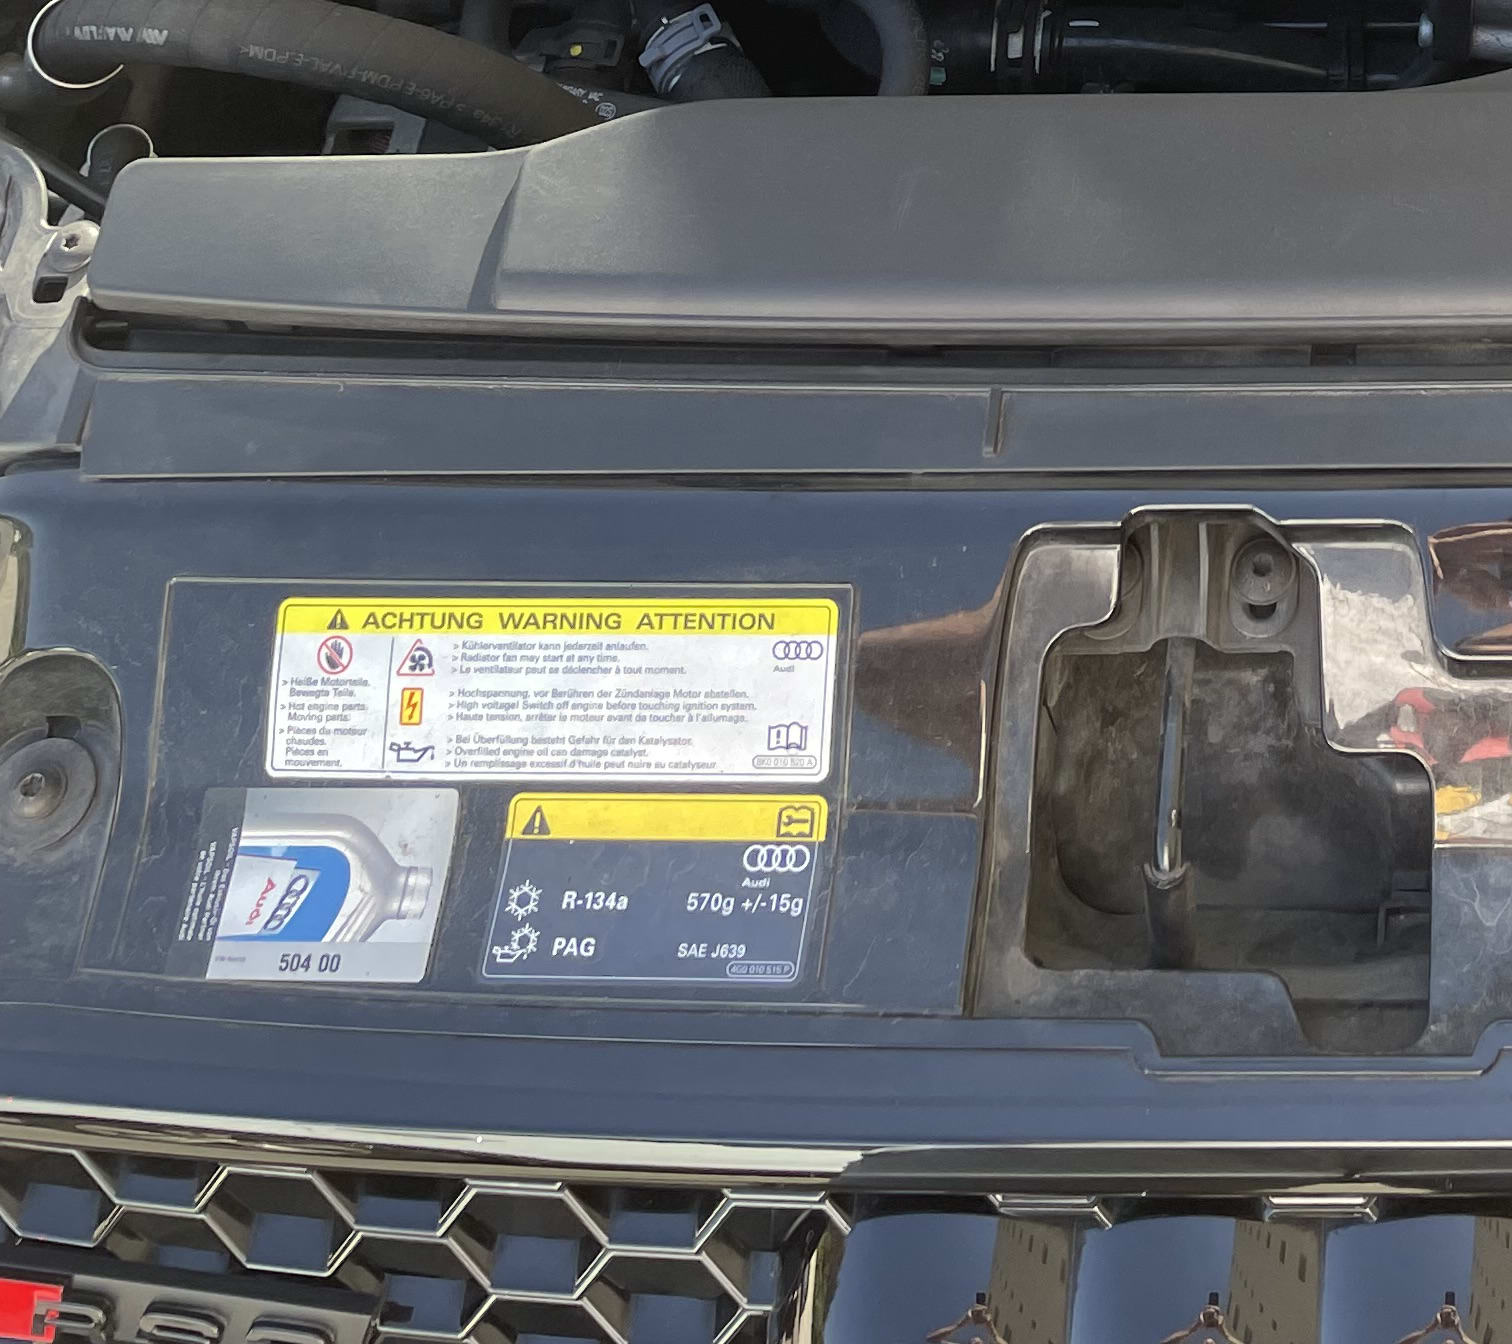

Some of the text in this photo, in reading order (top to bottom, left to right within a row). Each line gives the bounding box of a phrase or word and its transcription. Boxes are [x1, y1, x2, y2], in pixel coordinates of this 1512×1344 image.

[362, 611, 775, 631] ACHTUNG WARNING ATTENTION
[773, 665, 794, 673] Audi
[742, 877, 770, 888] Audi
[245, 877, 277, 925] Audi
[562, 891, 629, 911] R-134a
[686, 892, 804, 917] 570g +/-15g
[552, 937, 596, 957] PAG
[678, 943, 747, 958] SAE J639
[278, 954, 342, 972] 504 00
